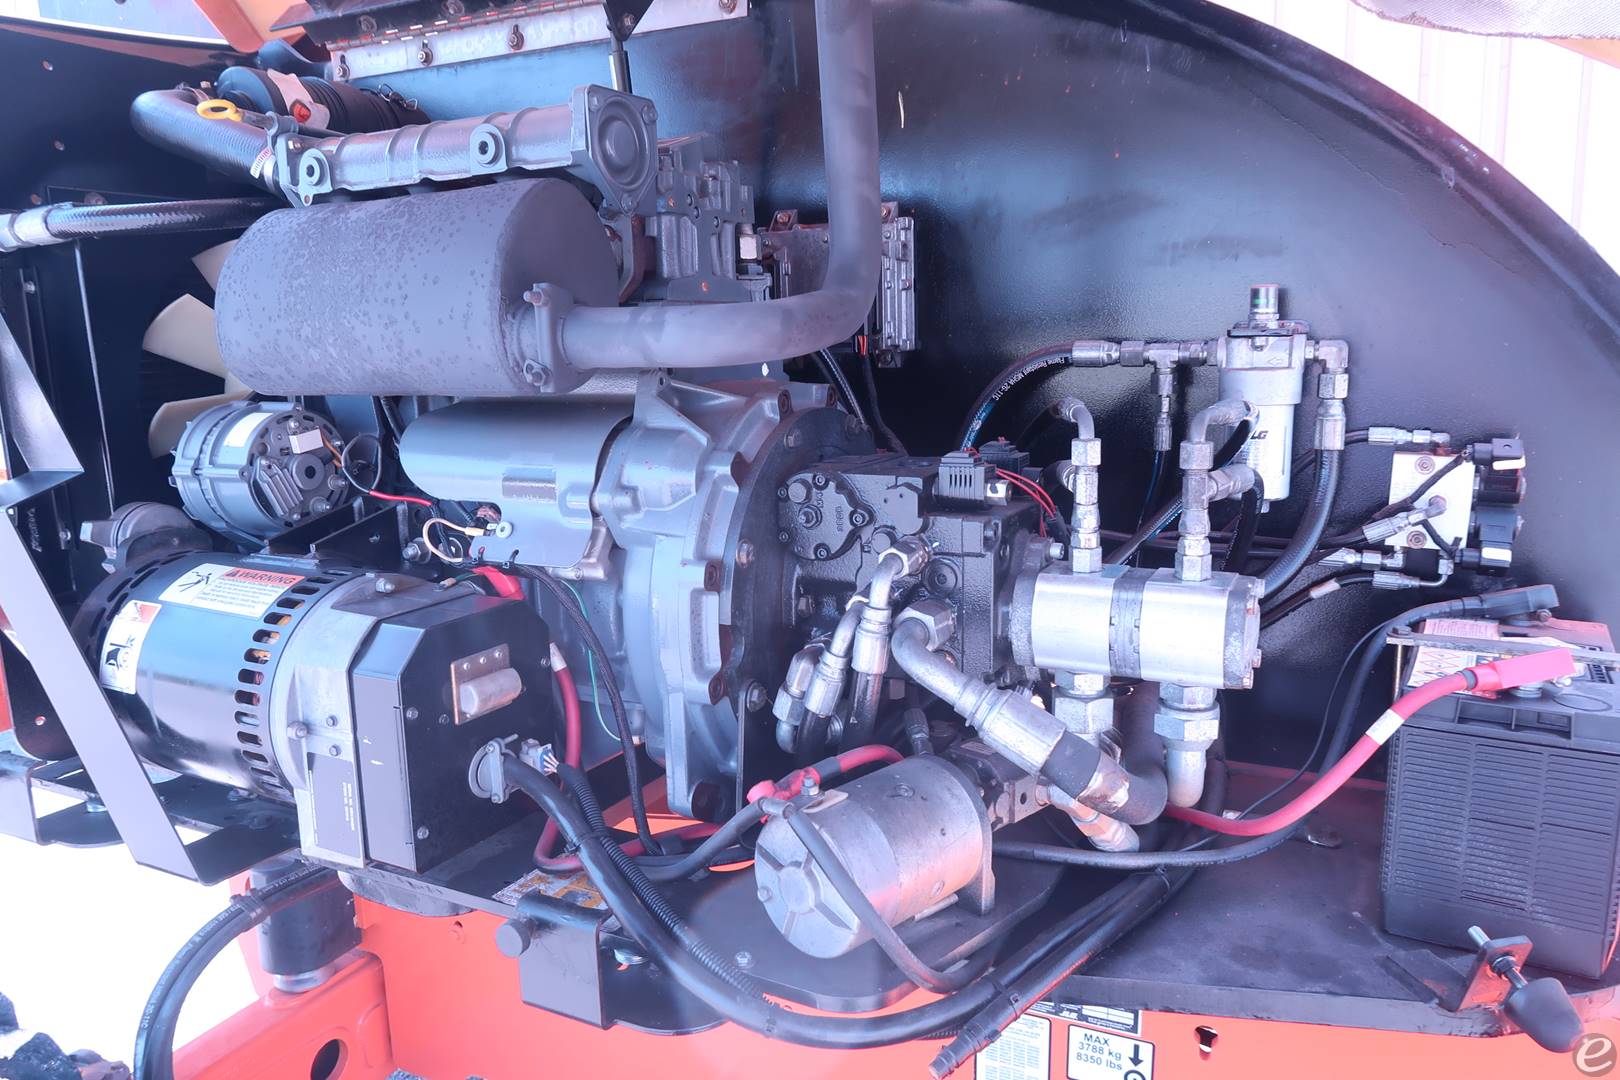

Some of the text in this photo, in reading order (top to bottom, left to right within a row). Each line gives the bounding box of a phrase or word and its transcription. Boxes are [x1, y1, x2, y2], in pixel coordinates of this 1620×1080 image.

[1047, 356, 1065, 365] Flame
[1249, 430, 1269, 440] LG
[237, 570, 297, 585] WARNING
[1083, 1032, 1110, 1047] MAX
[1078, 1041, 1121, 1062] 3788 kg
[1076, 1051, 1122, 1071] 8350 lbs
